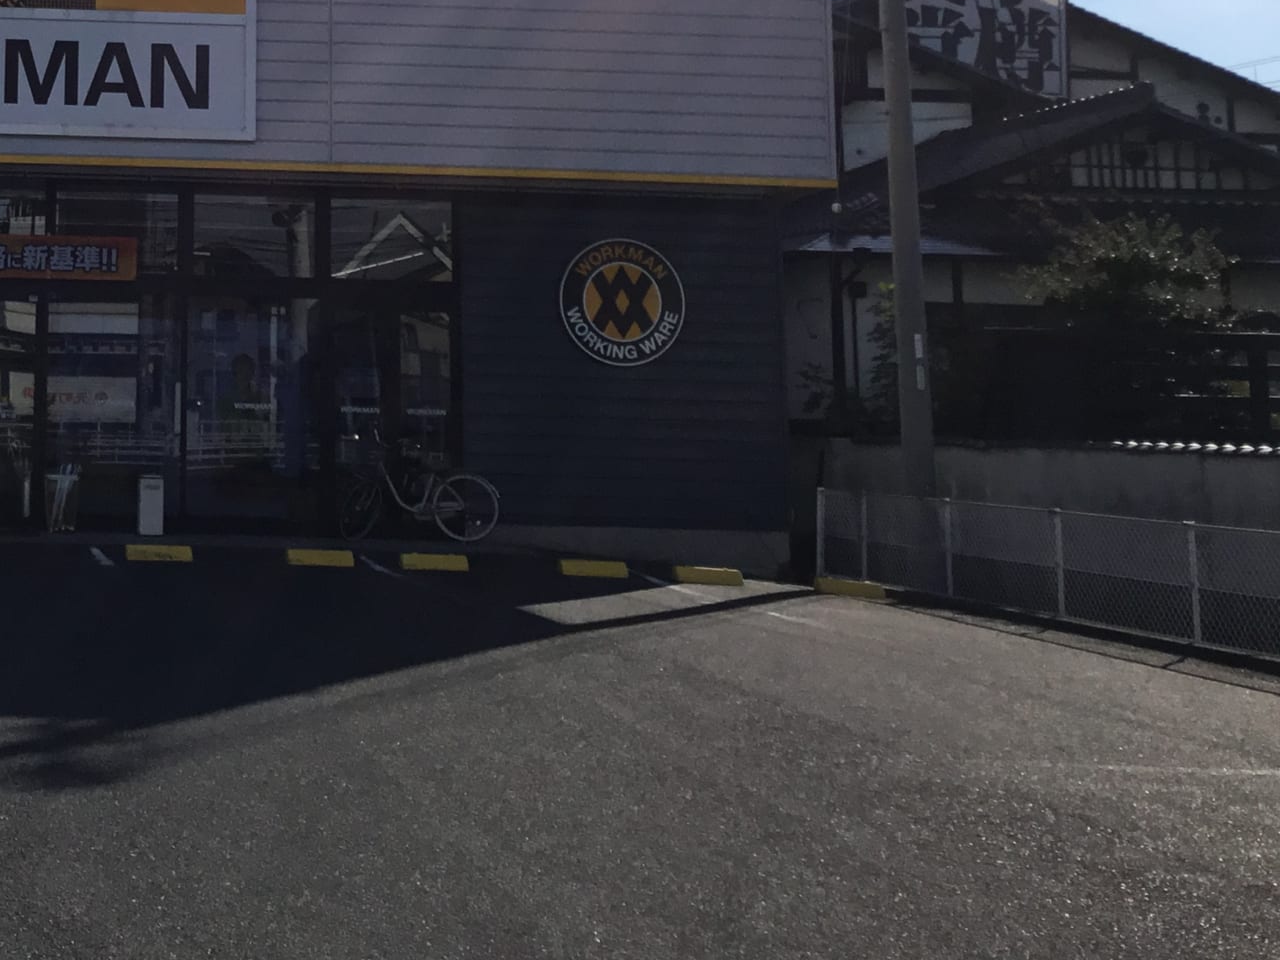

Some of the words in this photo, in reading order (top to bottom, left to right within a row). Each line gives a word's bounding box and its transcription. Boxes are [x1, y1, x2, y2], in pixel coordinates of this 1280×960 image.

[575, 244, 670, 280] WORKMAN
[566, 305, 639, 360] WORKING
[639, 309, 679, 355] WARE
